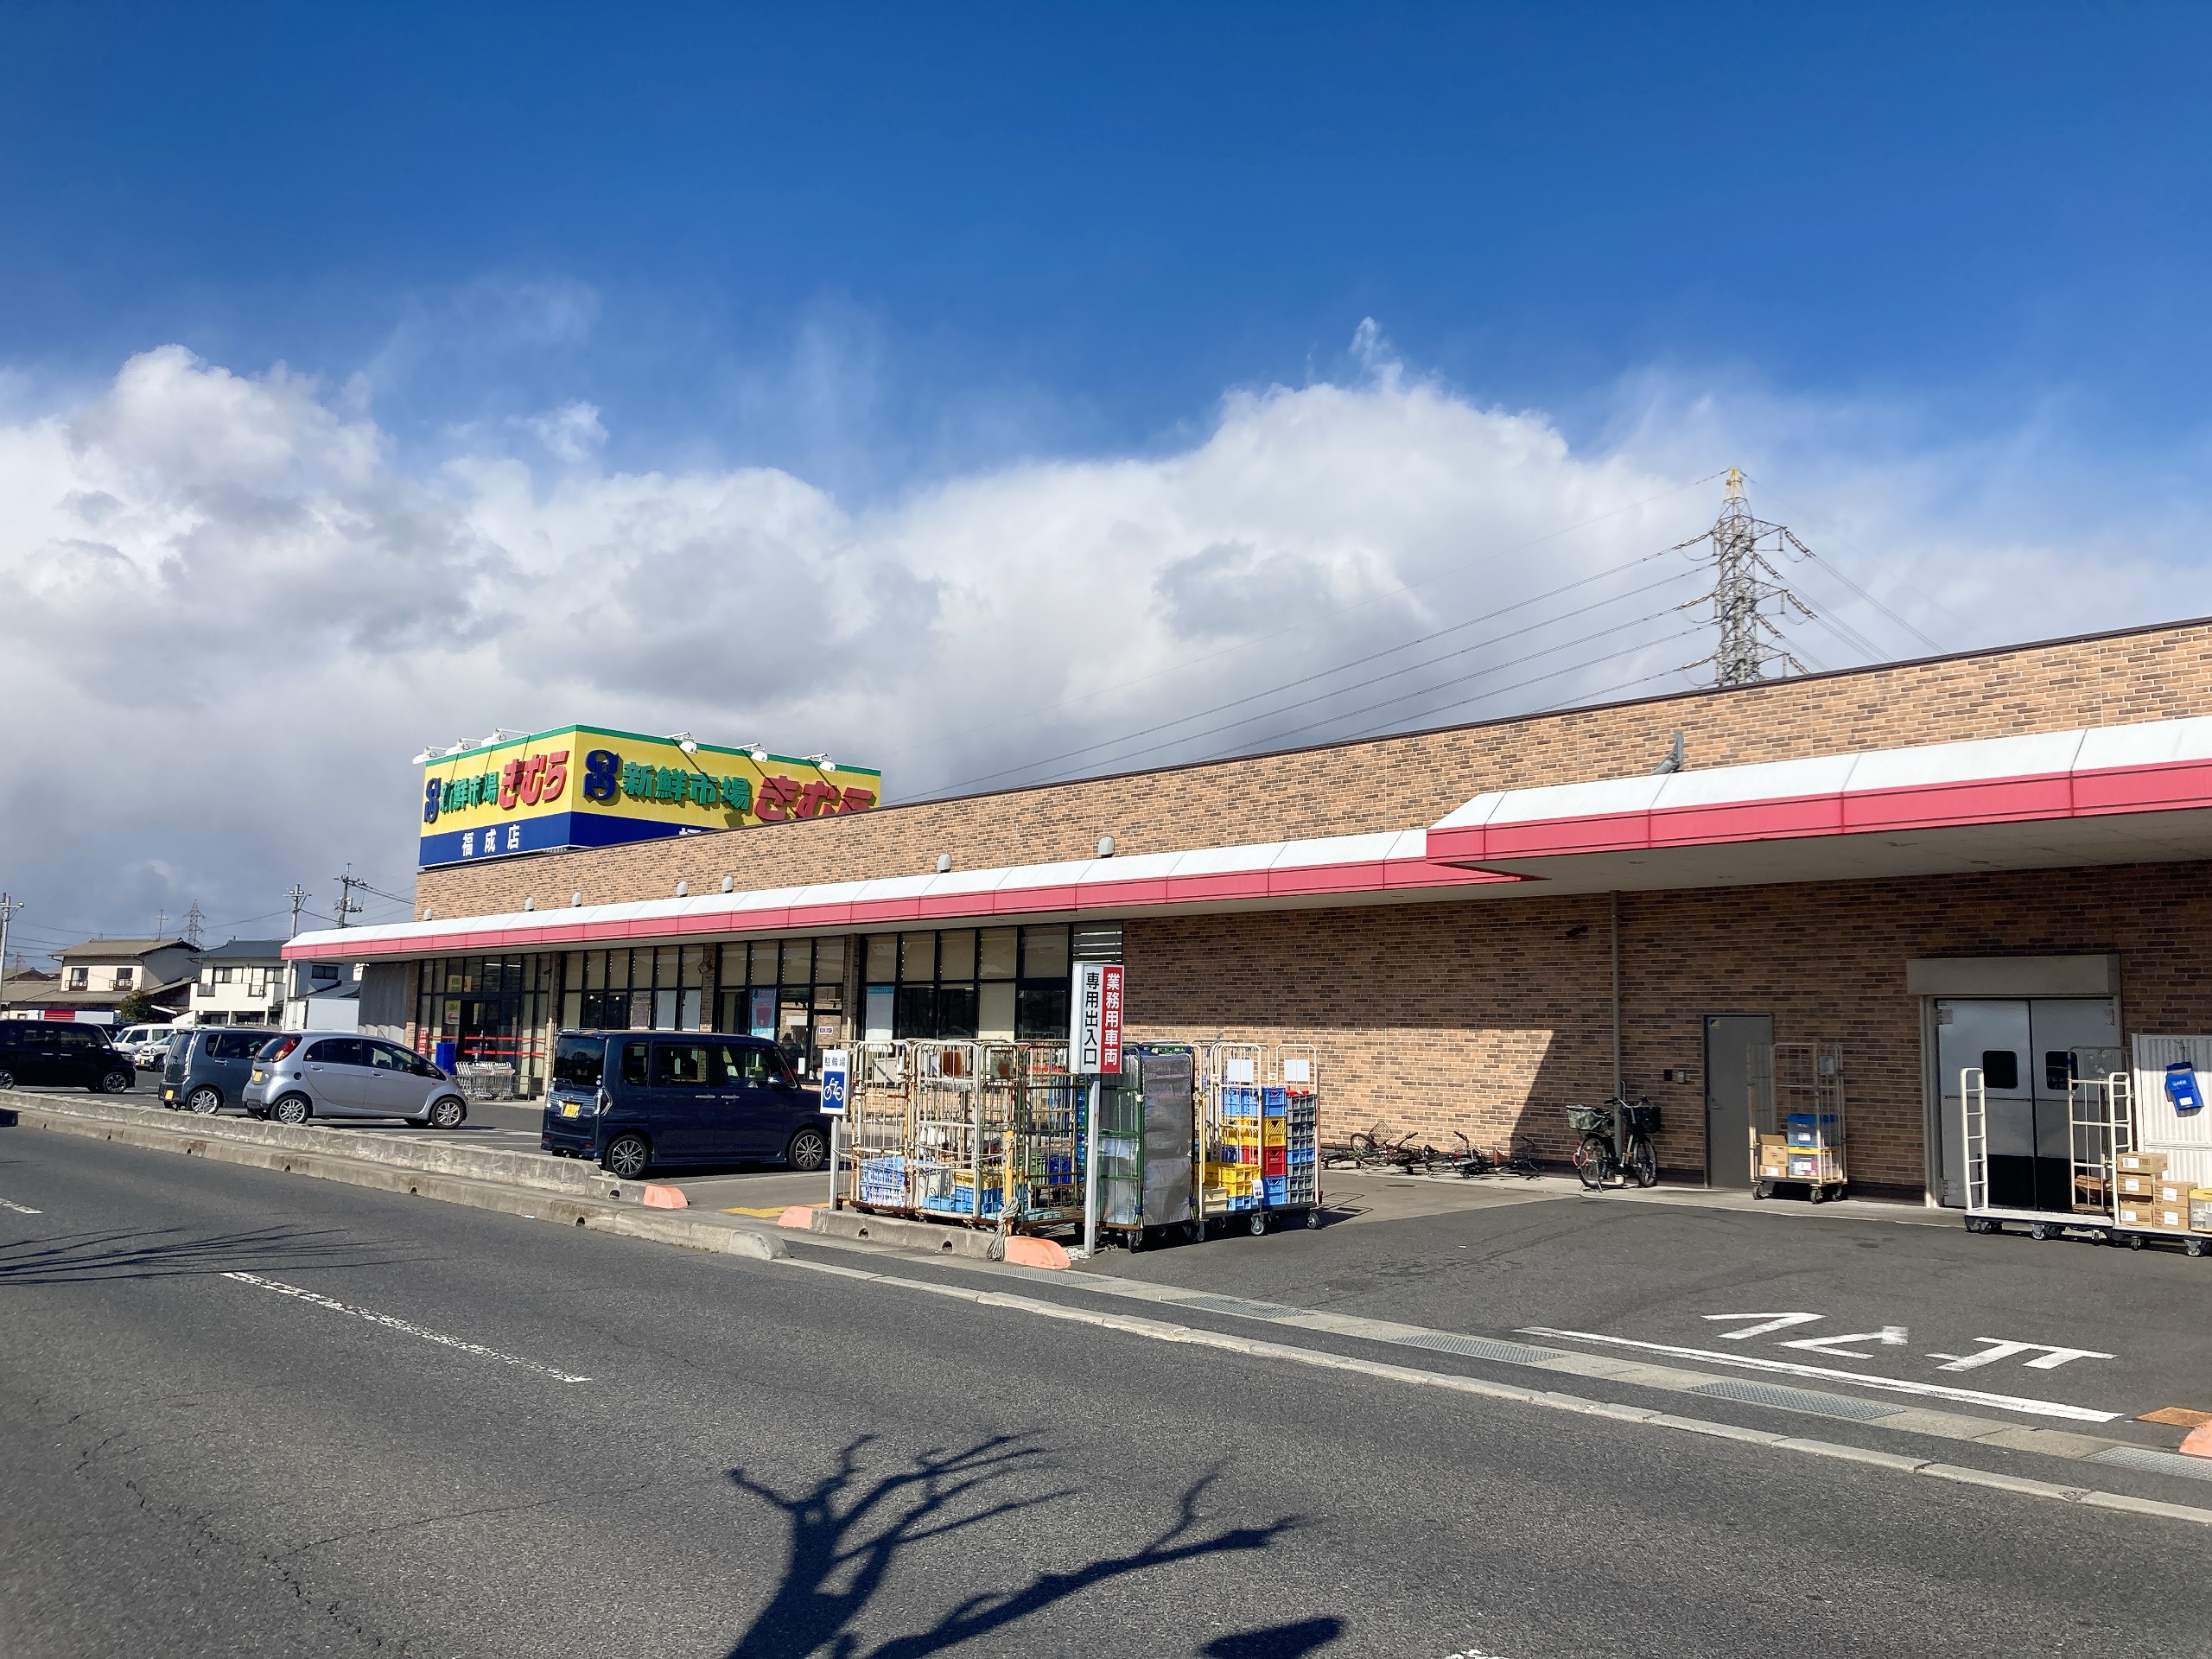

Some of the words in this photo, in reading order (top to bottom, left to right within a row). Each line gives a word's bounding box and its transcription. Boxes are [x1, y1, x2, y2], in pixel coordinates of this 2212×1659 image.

[440, 772, 499, 814] 新鮮市場
[499, 751, 569, 810] きむら
[622, 761, 748, 810] 新鮮市場
[461, 824, 520, 857] 福成店
[1084, 972, 1099, 1065] 専用出入口
[1104, 973, 1120, 1066] 業務用車両
[824, 1056, 846, 1067] 駐輪場
